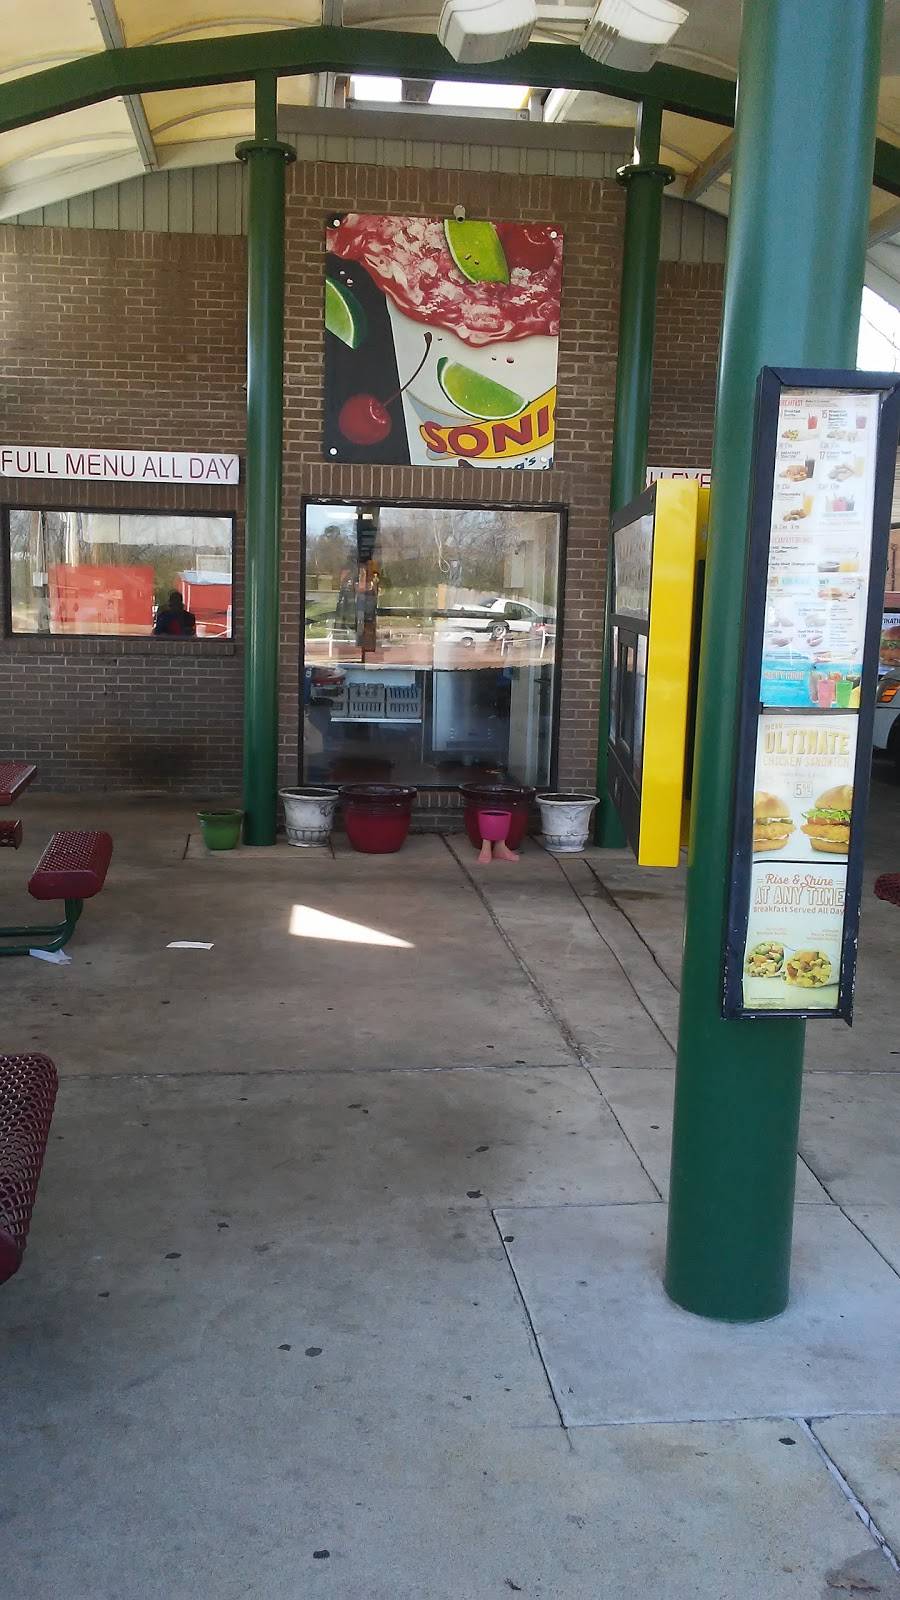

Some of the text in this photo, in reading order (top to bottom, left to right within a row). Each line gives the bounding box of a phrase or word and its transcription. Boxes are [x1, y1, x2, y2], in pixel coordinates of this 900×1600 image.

[1, 451, 234, 480] FULL MENU ALL DAY
[765, 731, 849, 755] ULTIMATE
[766, 873, 834, 888] Rise & Shine
[755, 885, 846, 907] AT ANY TIME
[789, 905, 816, 914] Served
[817, 906, 829, 914] All
[830, 907, 845, 916] Day
